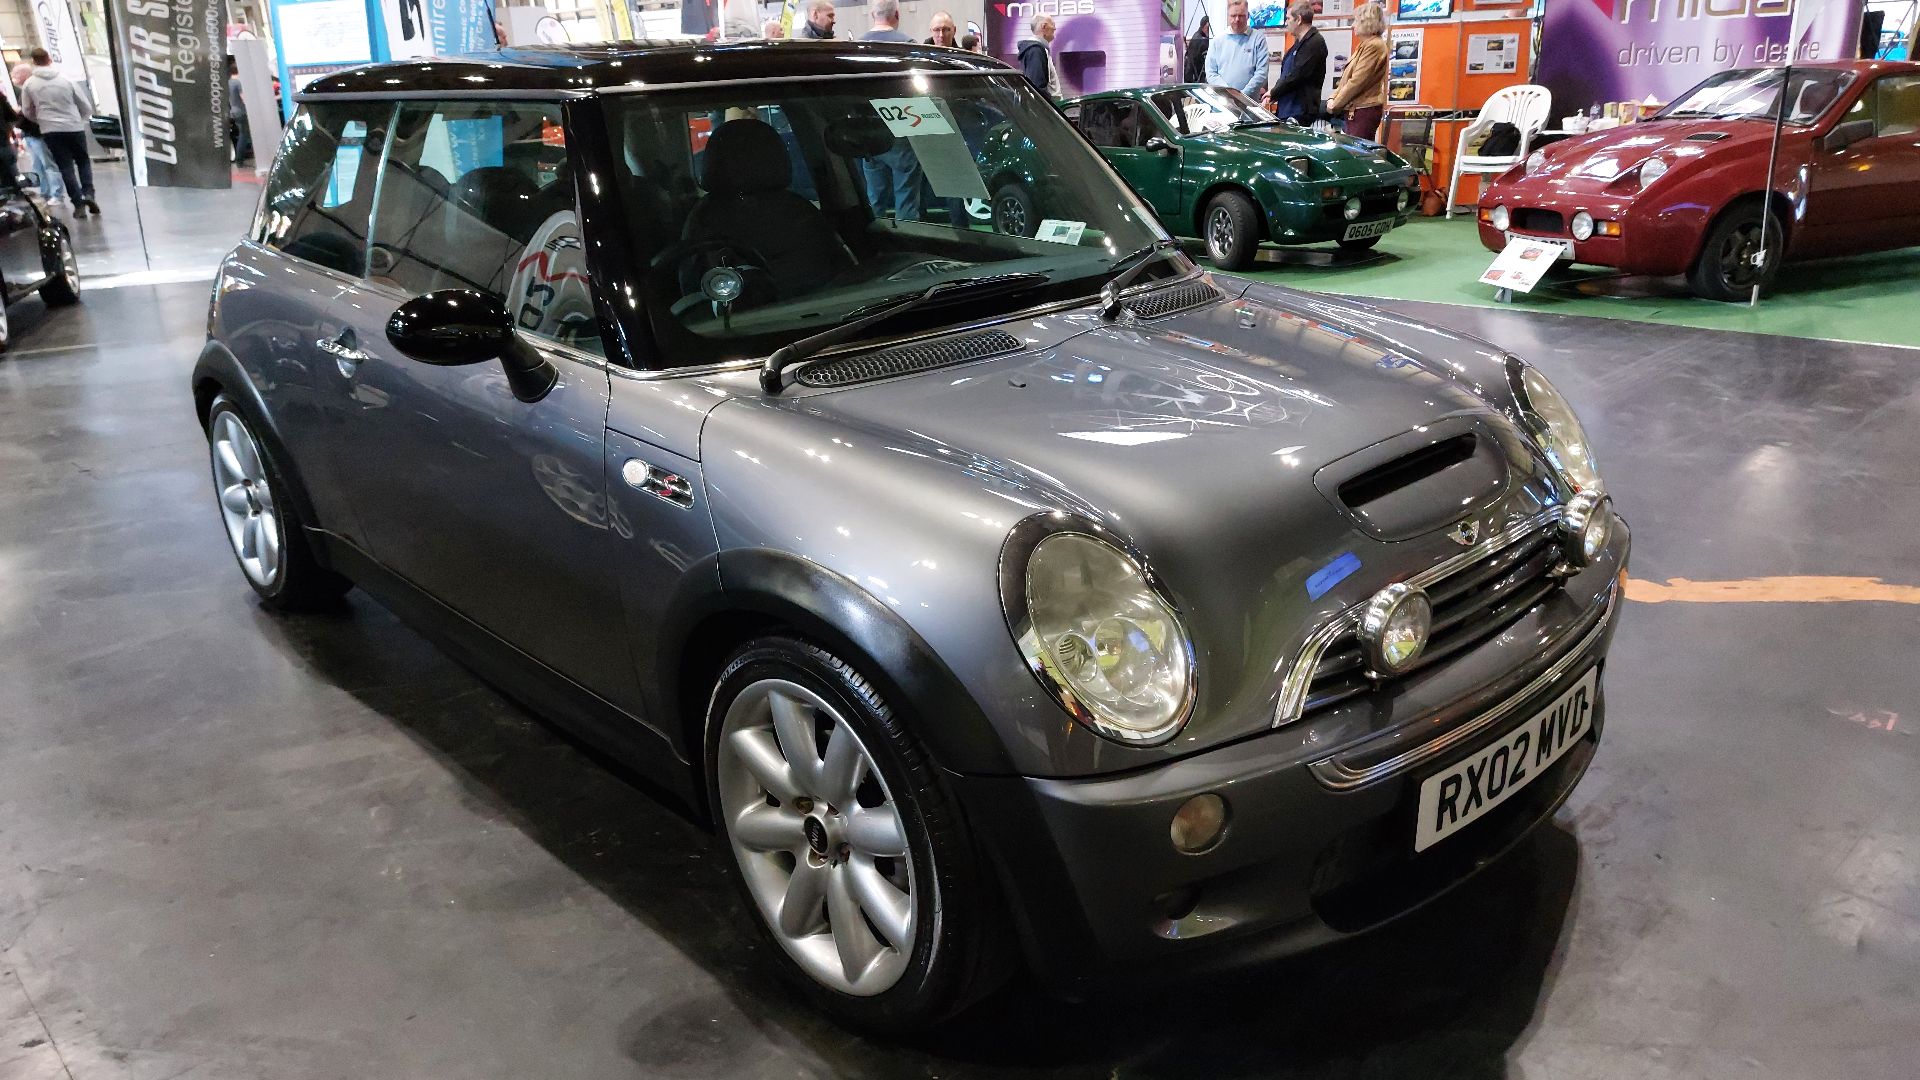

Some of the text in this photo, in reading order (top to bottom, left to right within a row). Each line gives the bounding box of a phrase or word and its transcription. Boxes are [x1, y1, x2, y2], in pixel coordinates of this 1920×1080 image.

[171, 0, 200, 84] Registe
[430, 0, 446, 55] inire
[1007, 0, 1096, 17] midas
[126, 0, 178, 165] COOPER S
[204, 0, 224, 148] www.coopersport500re
[1618, 40, 1700, 67] driven
[1713, 38, 1743, 68] by
[1436, 685, 1589, 833] RX02 MVD
